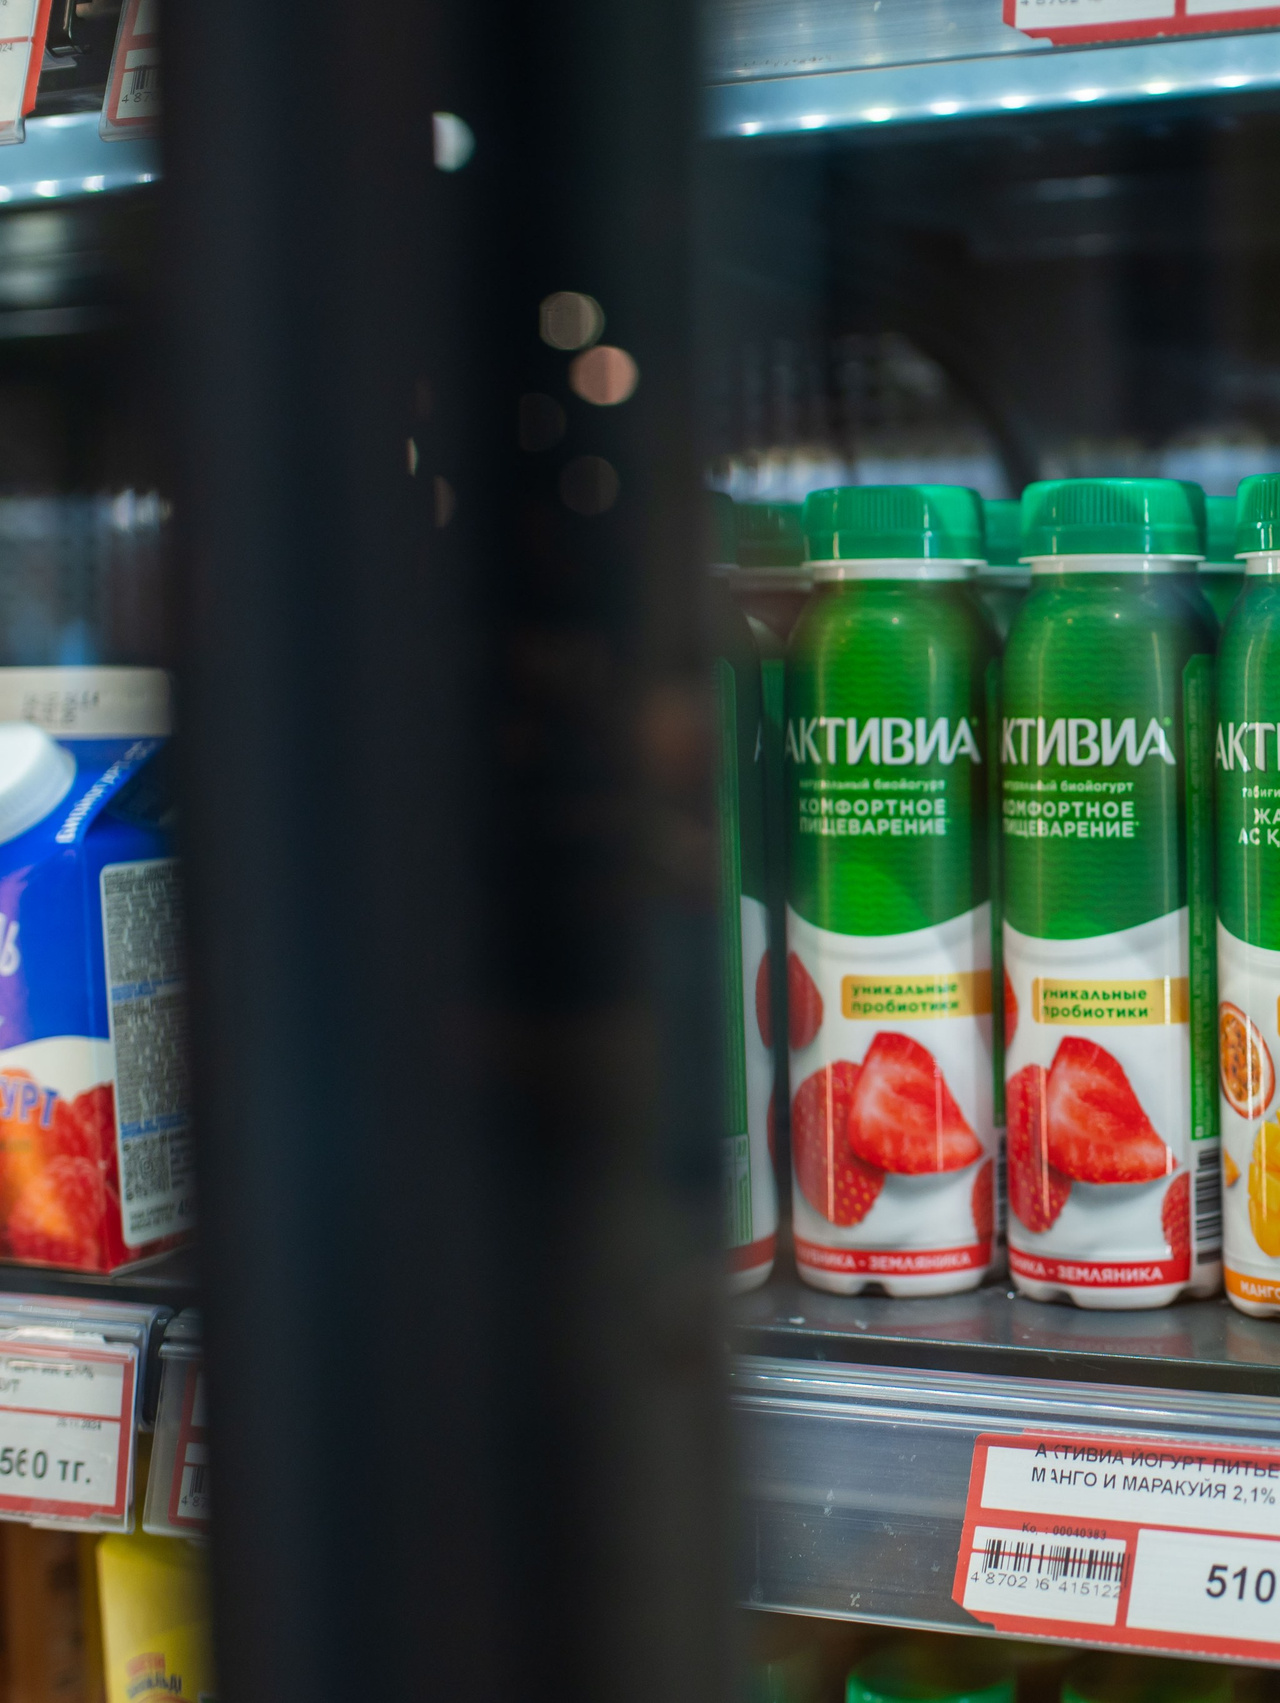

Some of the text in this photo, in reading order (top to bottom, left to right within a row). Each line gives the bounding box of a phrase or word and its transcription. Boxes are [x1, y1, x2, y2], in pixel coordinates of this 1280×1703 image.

[785, 716, 981, 765] АКТИВИА
[1002, 717, 1176, 766] КТИВИА
[1060, 780, 1134, 793] биойогурт
[800, 797, 946, 816] КОМФОРТНОЕ
[1238, 828, 1260, 845] АС
[1043, 988, 1147, 1001] уникальные
[1043, 1003, 1148, 1018] пробиотики
[1131, 1448, 1207, 1472] ЙОГУРТ
[57, 1460, 91, 1484] тг.
[1103, 1473, 1116, 1489] И
[1122, 1475, 1226, 1499] МАРАКУЙЯ
[1233, 1485, 1276, 1504] 2,1%
[970, 1572, 980, 1583] 4
[1206, 1564, 1276, 1602] 510
